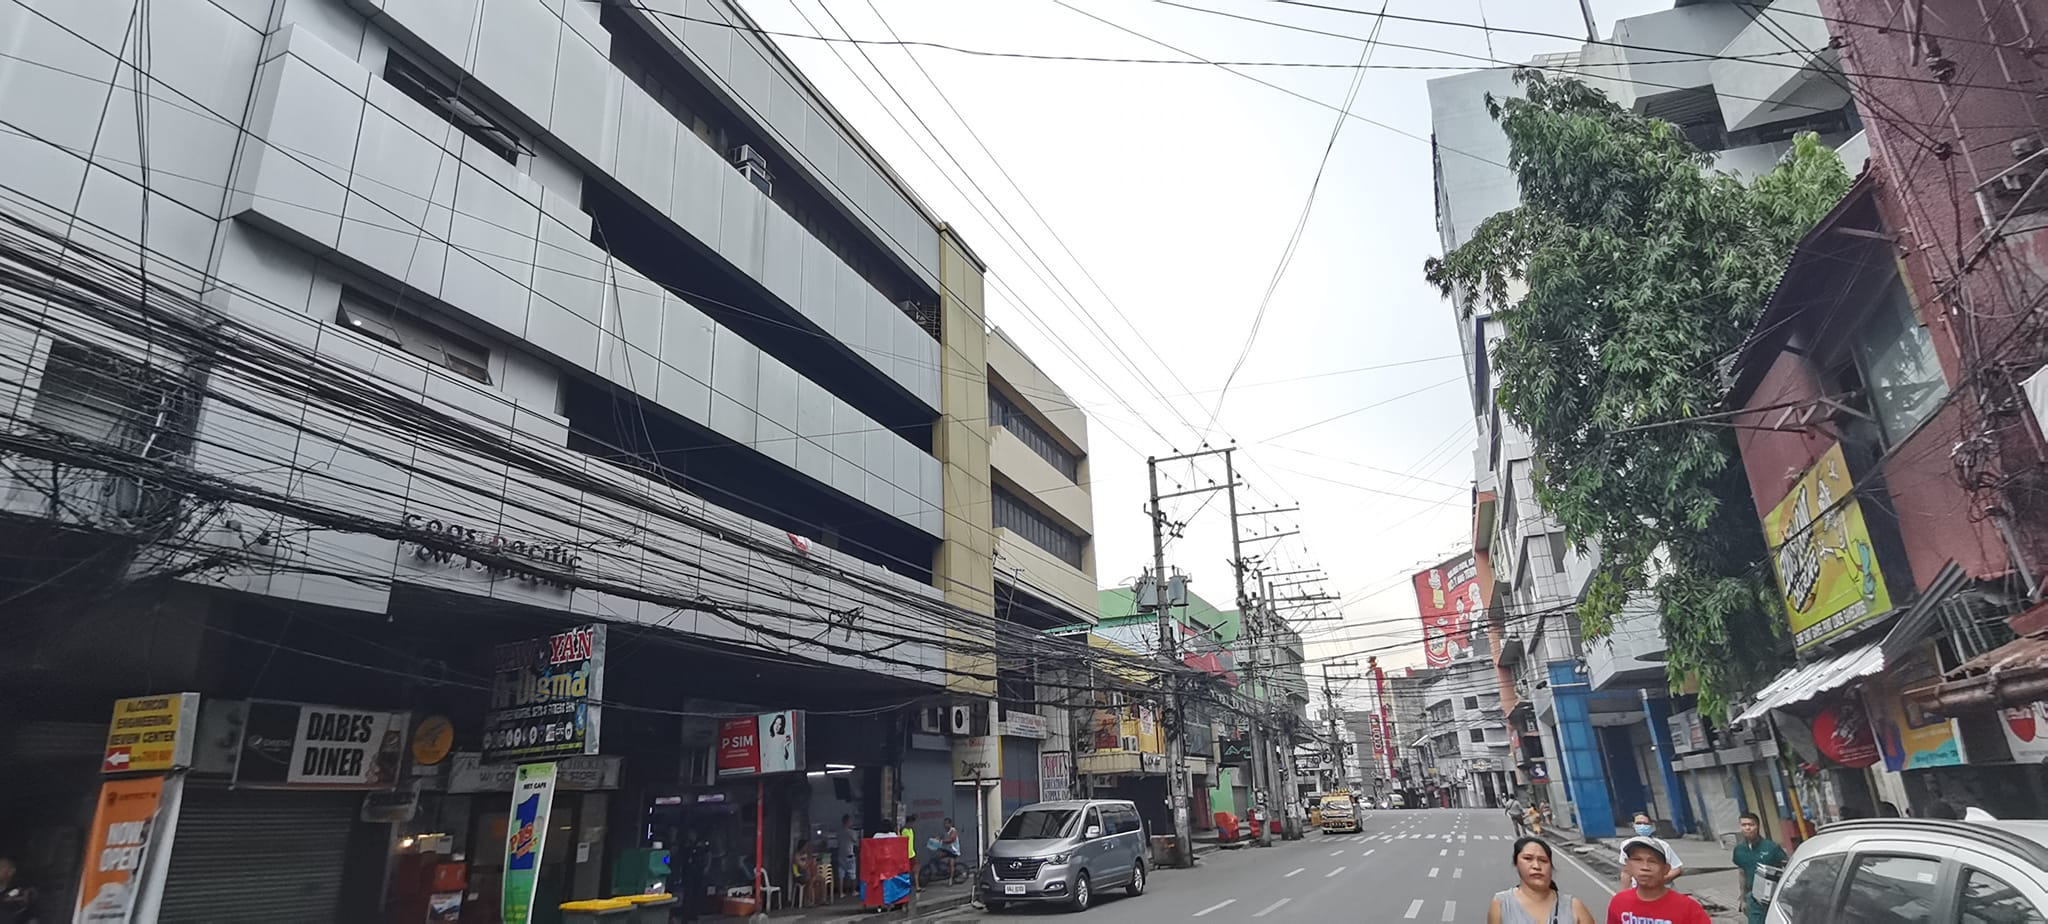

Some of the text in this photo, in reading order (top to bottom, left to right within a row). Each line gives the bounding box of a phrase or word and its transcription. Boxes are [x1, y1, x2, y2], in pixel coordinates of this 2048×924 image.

[306, 712, 374, 743] DABES
[731, 735, 754, 748] SIM
[302, 747, 364, 776] DINER
